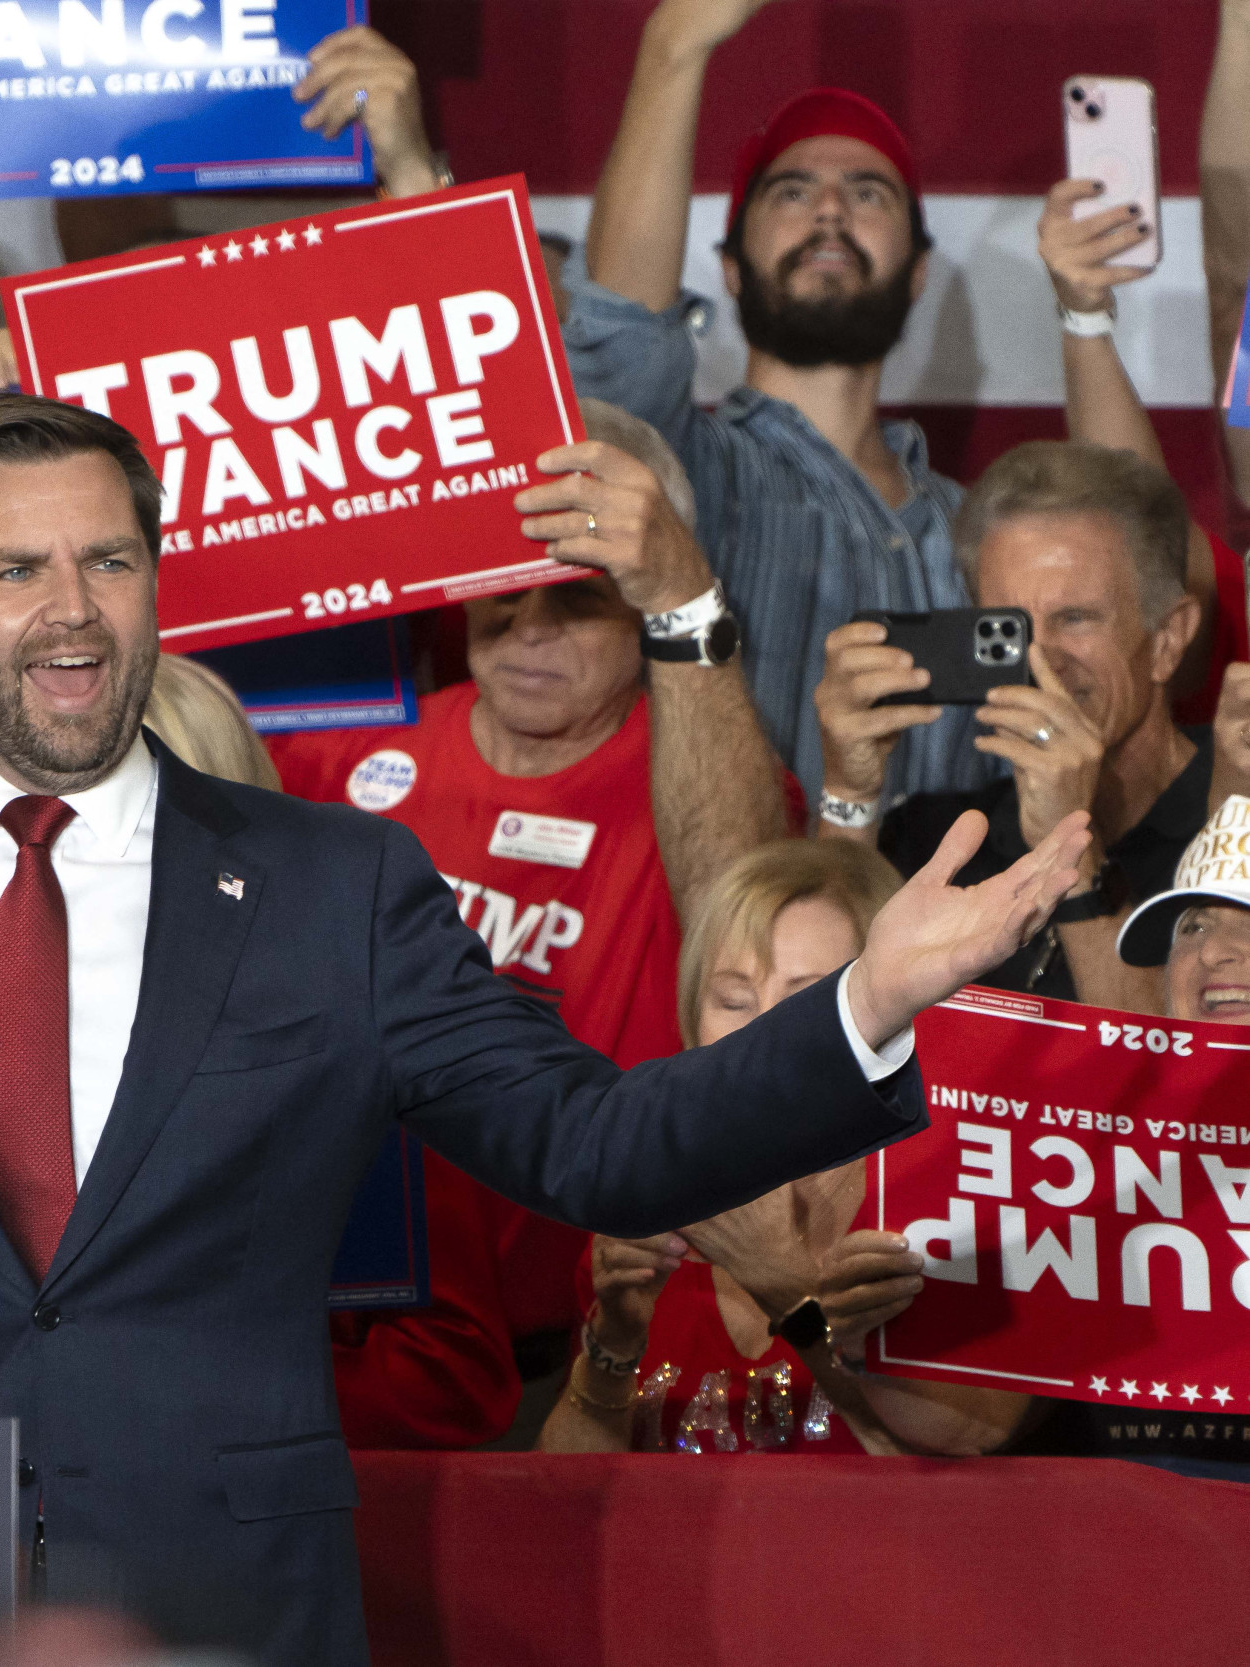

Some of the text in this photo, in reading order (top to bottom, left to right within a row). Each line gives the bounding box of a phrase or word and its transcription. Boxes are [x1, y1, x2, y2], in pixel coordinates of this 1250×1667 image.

[104, 70, 196, 96] GREAT
[49, 154, 145, 186] 2024
[54, 289, 520, 445] TRUMP
[160, 462, 531, 555] KE AMERICA GREAT AGAIN!
[300, 579, 393, 620] 2024
[1098, 1020, 1194, 1057] 2024
[930, 1084, 1029, 1121] AGAIN!
[1039, 1104, 1135, 1135] GREAT
